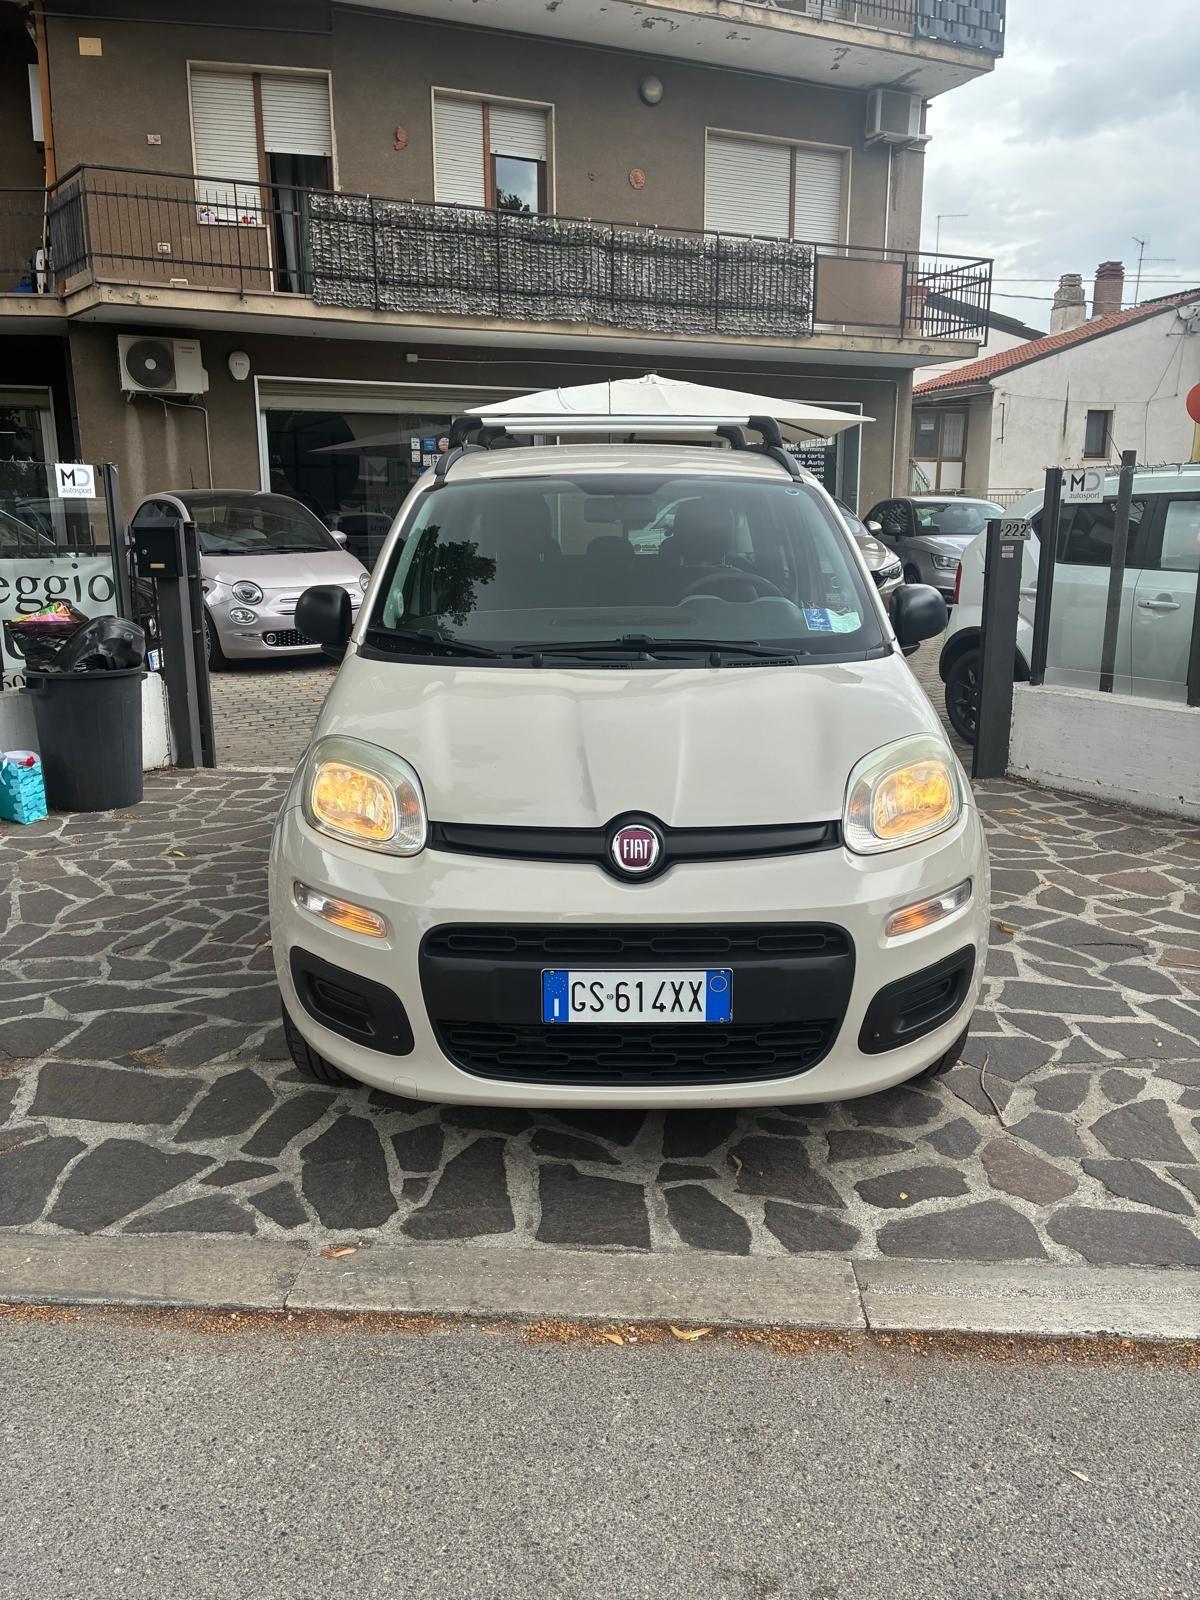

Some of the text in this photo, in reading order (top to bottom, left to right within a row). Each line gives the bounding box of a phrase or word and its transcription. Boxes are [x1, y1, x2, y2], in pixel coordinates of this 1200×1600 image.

[61, 468, 90, 487] MD
[1070, 472, 1101, 492] MD
[62, 487, 92, 496] autosport
[1069, 492, 1100, 501] autosport
[1005, 523, 1027, 537] 222
[623, 838, 650, 859] FIAT
